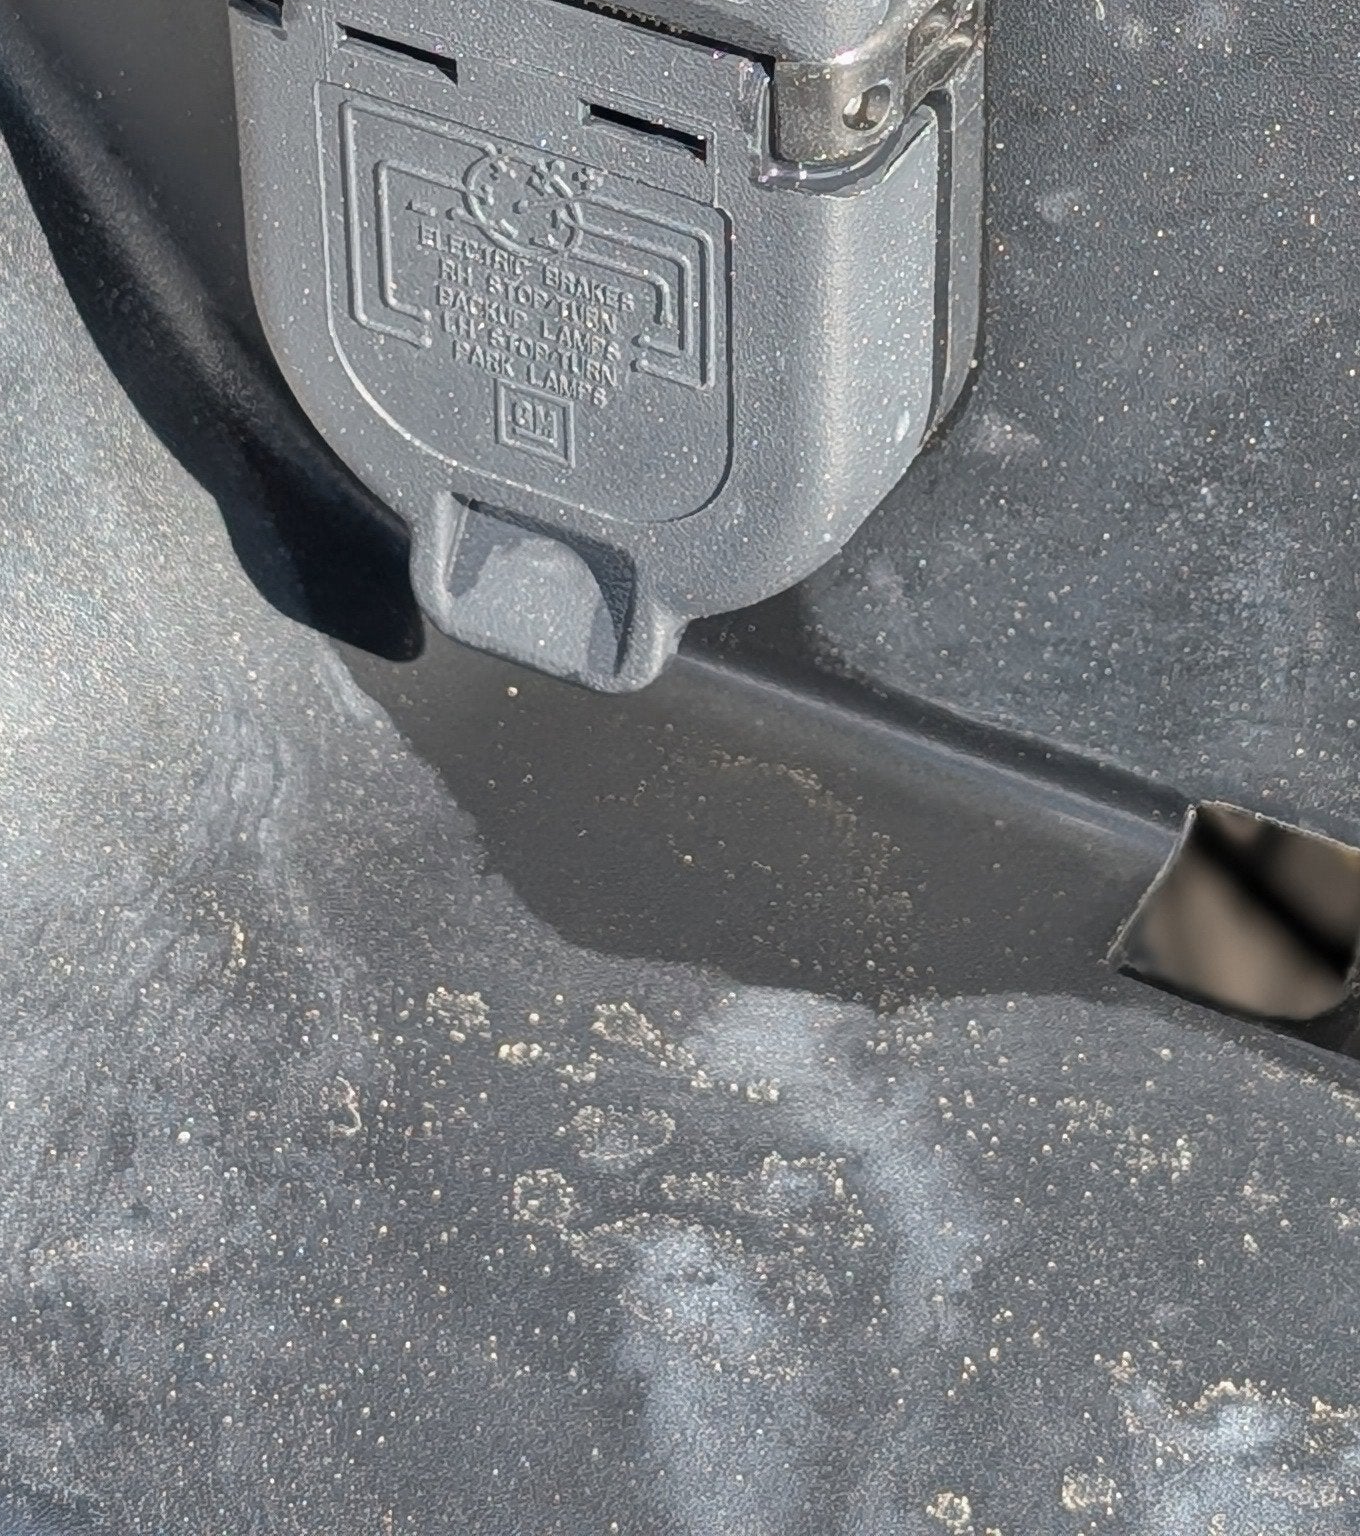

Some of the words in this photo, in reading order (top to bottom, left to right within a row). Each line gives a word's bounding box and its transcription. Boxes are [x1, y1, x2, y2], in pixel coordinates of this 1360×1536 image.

[418, 219, 532, 275] ELECTRIC
[542, 265, 635, 312] BRAKES
[439, 257, 473, 287] RH
[436, 285, 528, 329] BACKUP
[541, 319, 622, 361] LAMPS
[441, 310, 477, 339] LH
[453, 339, 515, 377] PARK
[527, 363, 608, 409] LAMPS
[511, 399, 558, 448] GM
